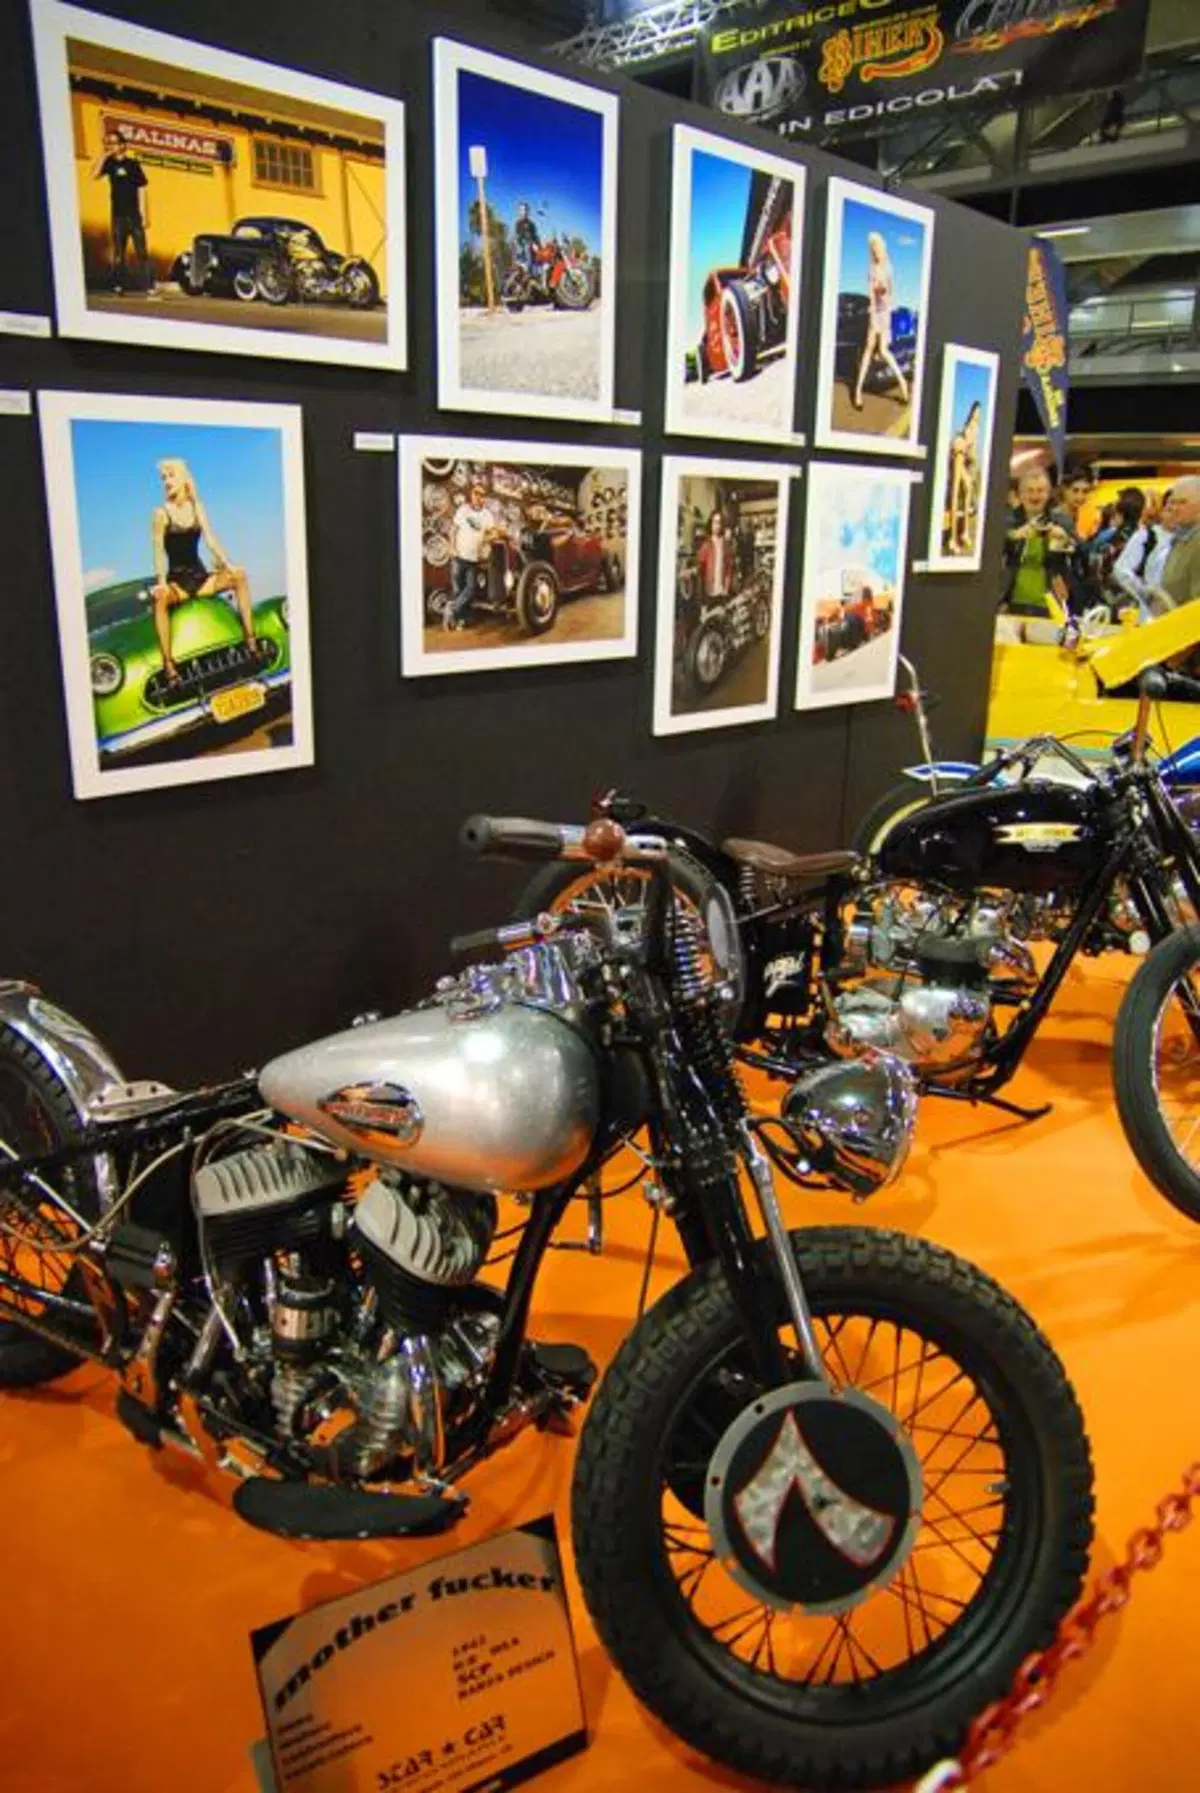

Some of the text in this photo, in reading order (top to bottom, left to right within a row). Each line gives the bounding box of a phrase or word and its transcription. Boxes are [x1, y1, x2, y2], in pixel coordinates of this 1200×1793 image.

[778, 116, 812, 135] IN
[274, 1567, 555, 1712] mother fucker
